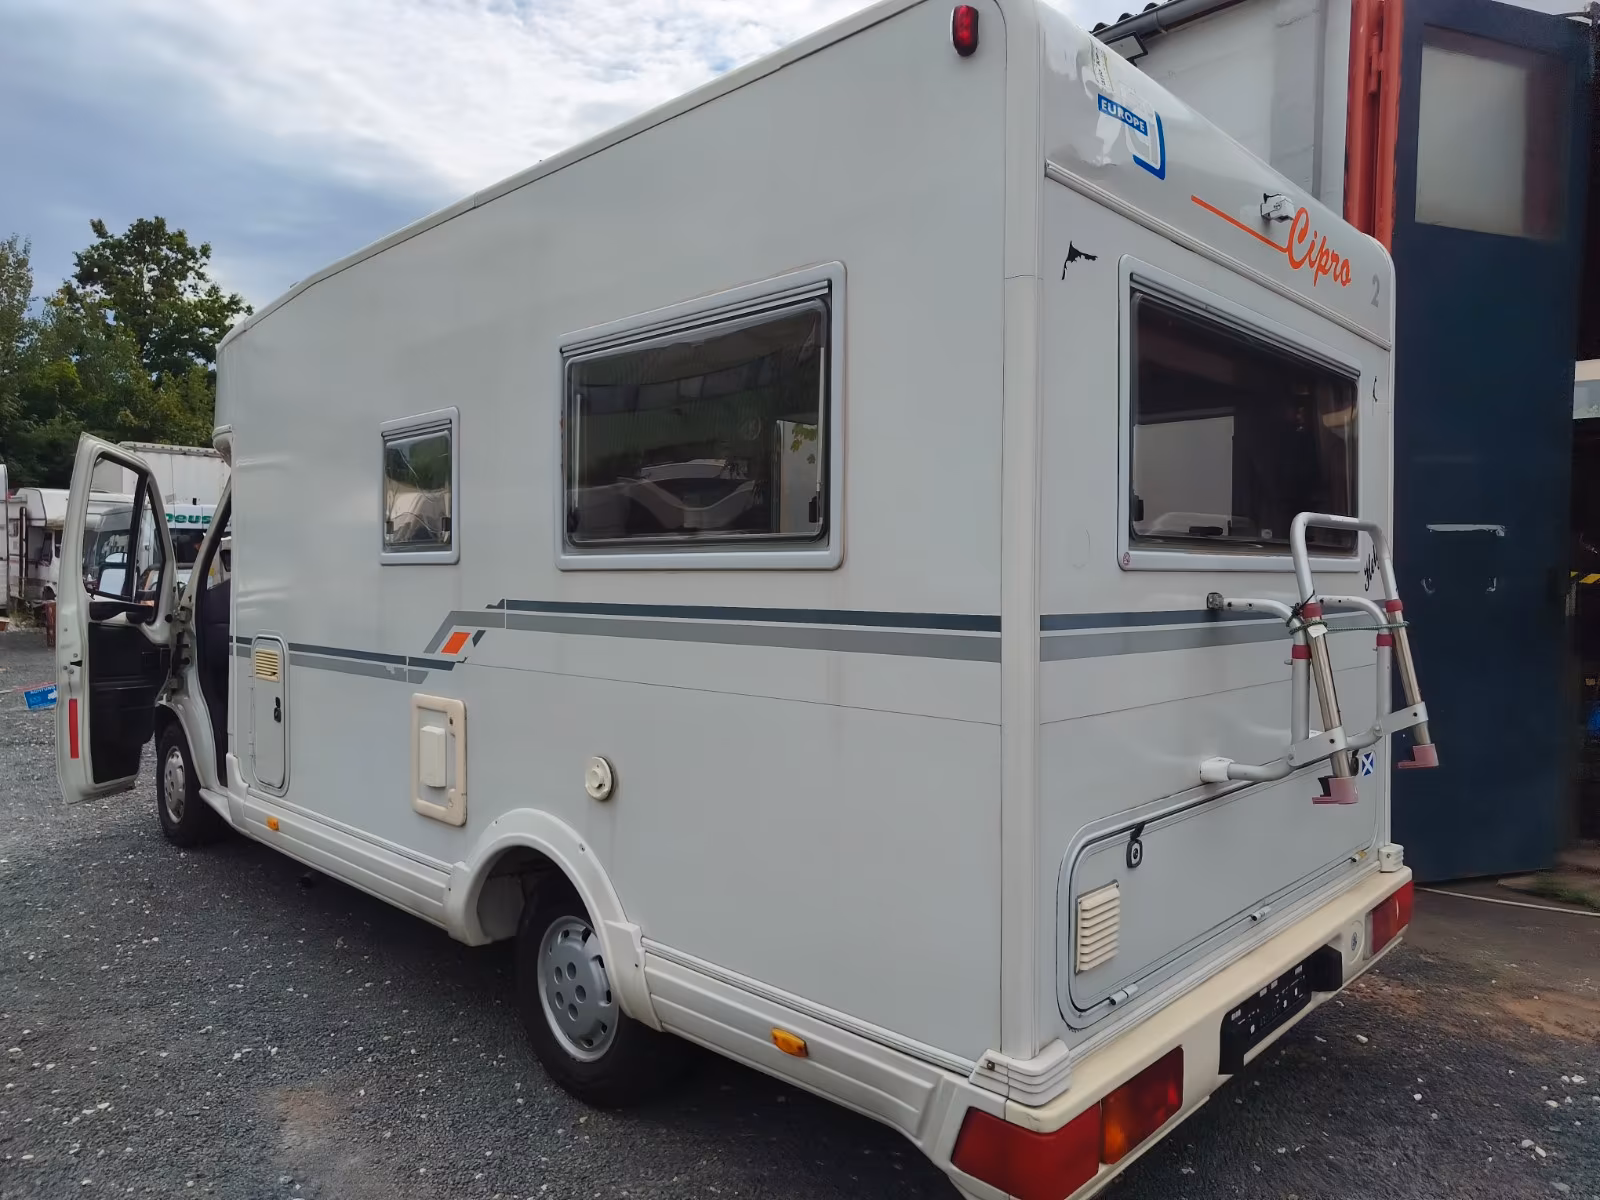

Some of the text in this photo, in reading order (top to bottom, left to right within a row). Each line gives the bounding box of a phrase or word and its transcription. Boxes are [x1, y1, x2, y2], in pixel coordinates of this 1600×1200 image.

[1100, 98, 1146, 133] EUROPE
[1286, 206, 1381, 309] Cipro 2
